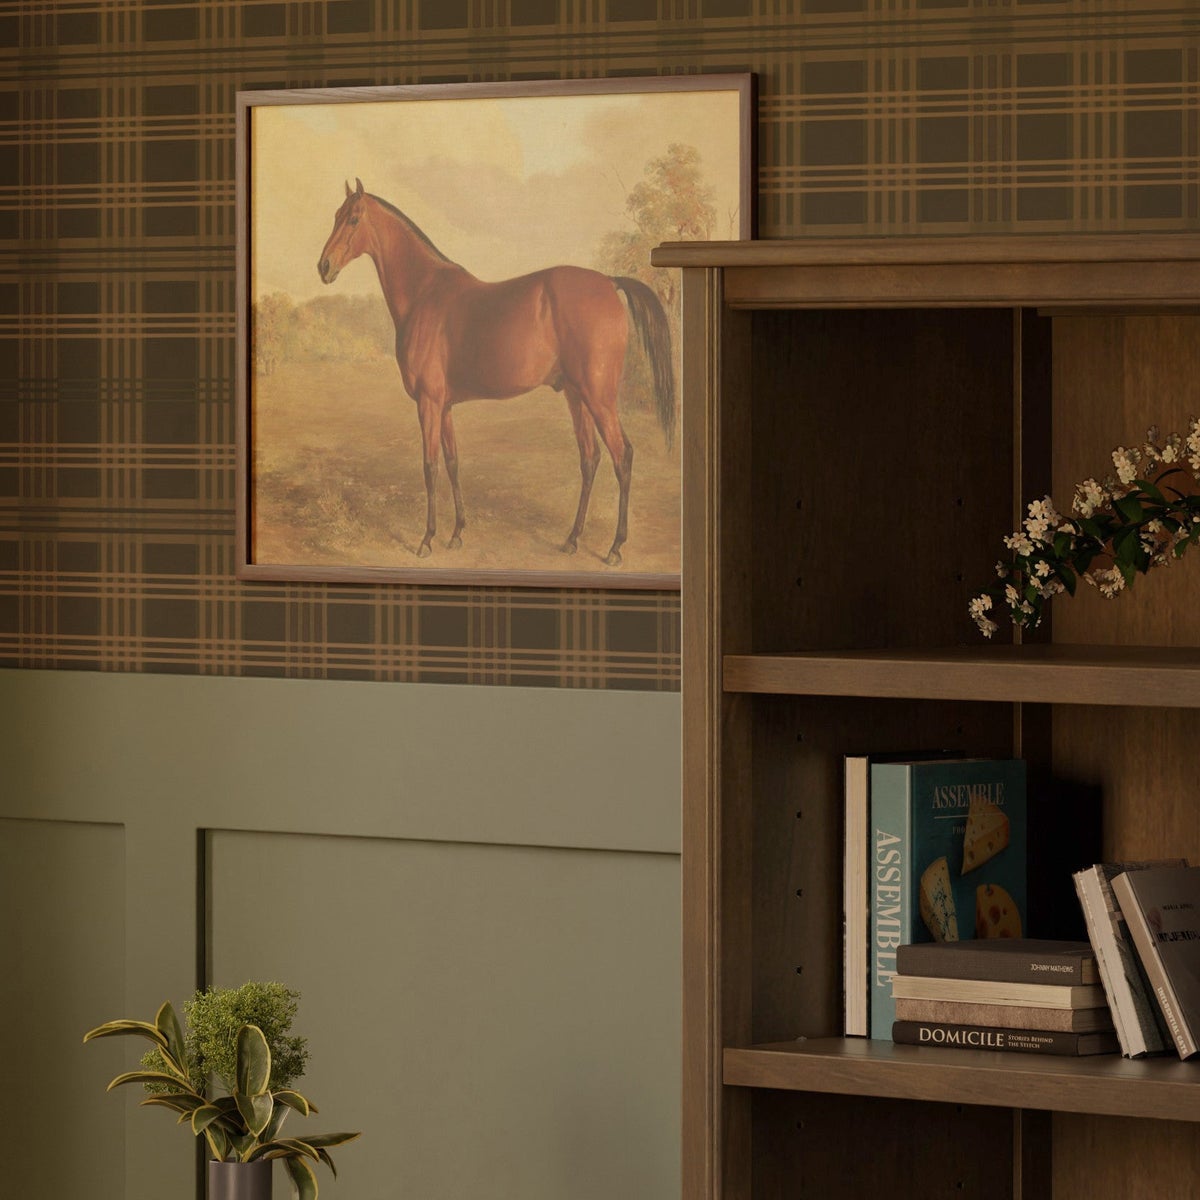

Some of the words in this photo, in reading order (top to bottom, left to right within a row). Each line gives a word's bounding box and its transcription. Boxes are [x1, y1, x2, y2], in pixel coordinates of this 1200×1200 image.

[932, 783, 1006, 809] ASSEMBLE
[876, 829, 902, 987] ASSEMBLE
[918, 1027, 1005, 1047] DOMICILE
